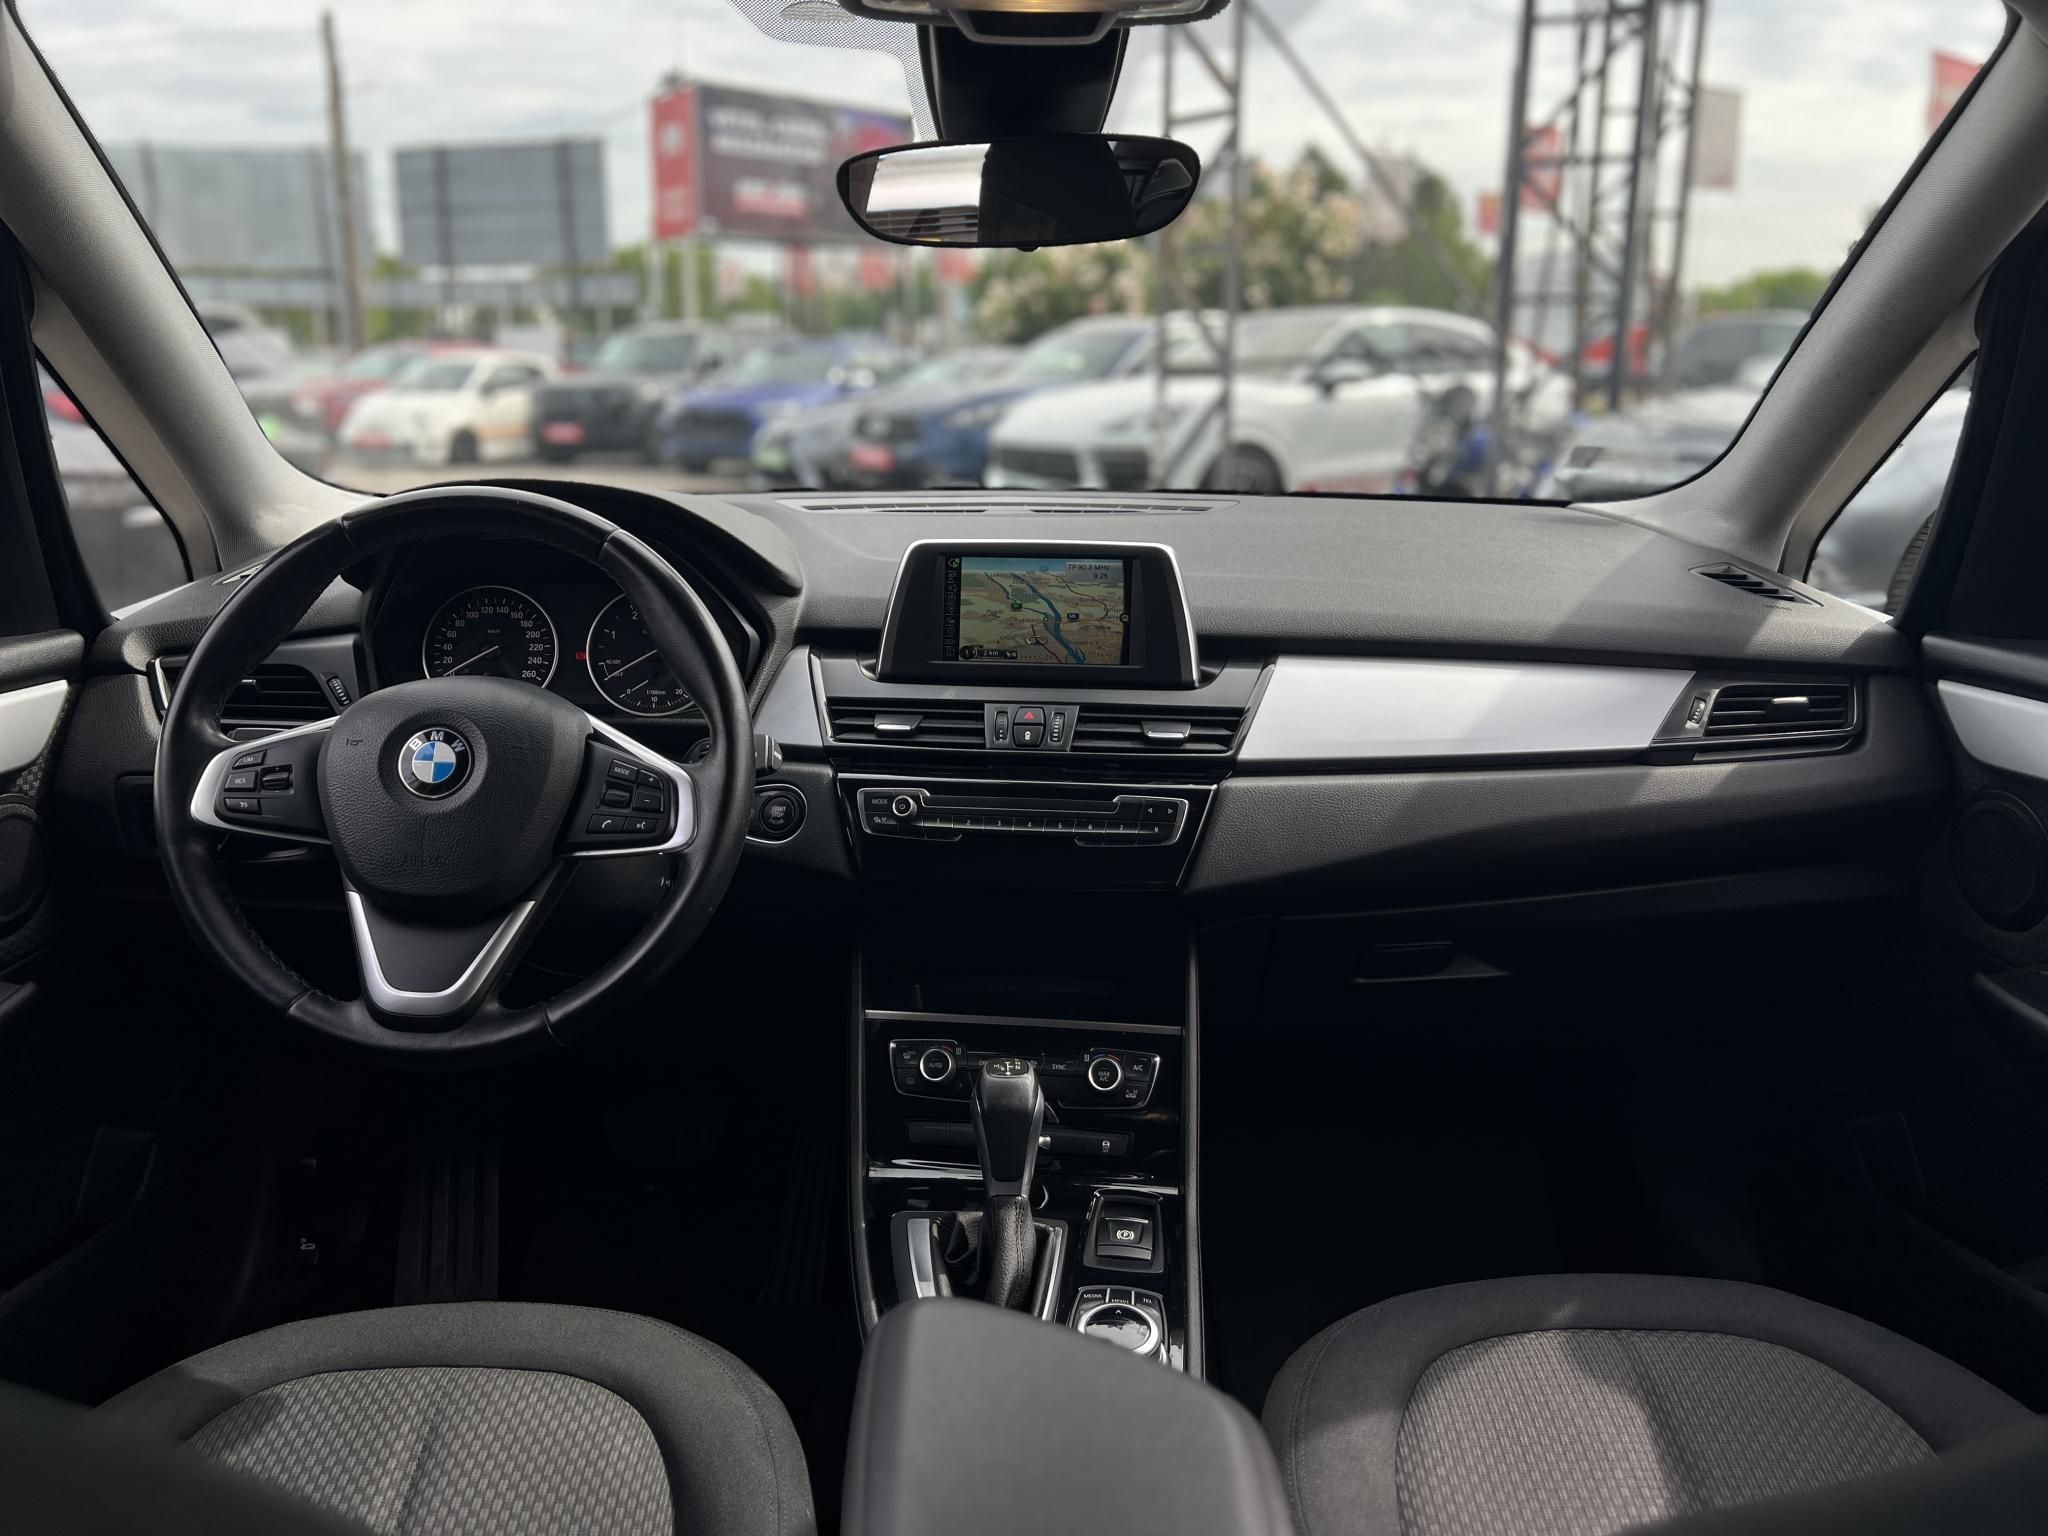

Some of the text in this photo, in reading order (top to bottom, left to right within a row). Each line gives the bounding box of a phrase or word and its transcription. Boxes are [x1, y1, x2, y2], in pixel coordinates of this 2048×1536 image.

[481, 606, 494, 614] 120
[496, 606, 509, 614] 140
[466, 611, 479, 619] 100
[511, 611, 523, 619] 160
[631, 611, 639, 620] 2
[520, 620, 533, 628] 180
[446, 630, 457, 638] 60
[525, 630, 541, 639] 200
[442, 643, 453, 651] 40
[529, 643, 544, 651] 220
[442, 656, 453, 664] 20
[527, 656, 543, 665] 240
[521, 670, 537, 678] 260
[408, 730, 466, 753] BMW
[613, 766, 631, 776] MODE
[1051, 1063, 1066, 1071] SYNC
